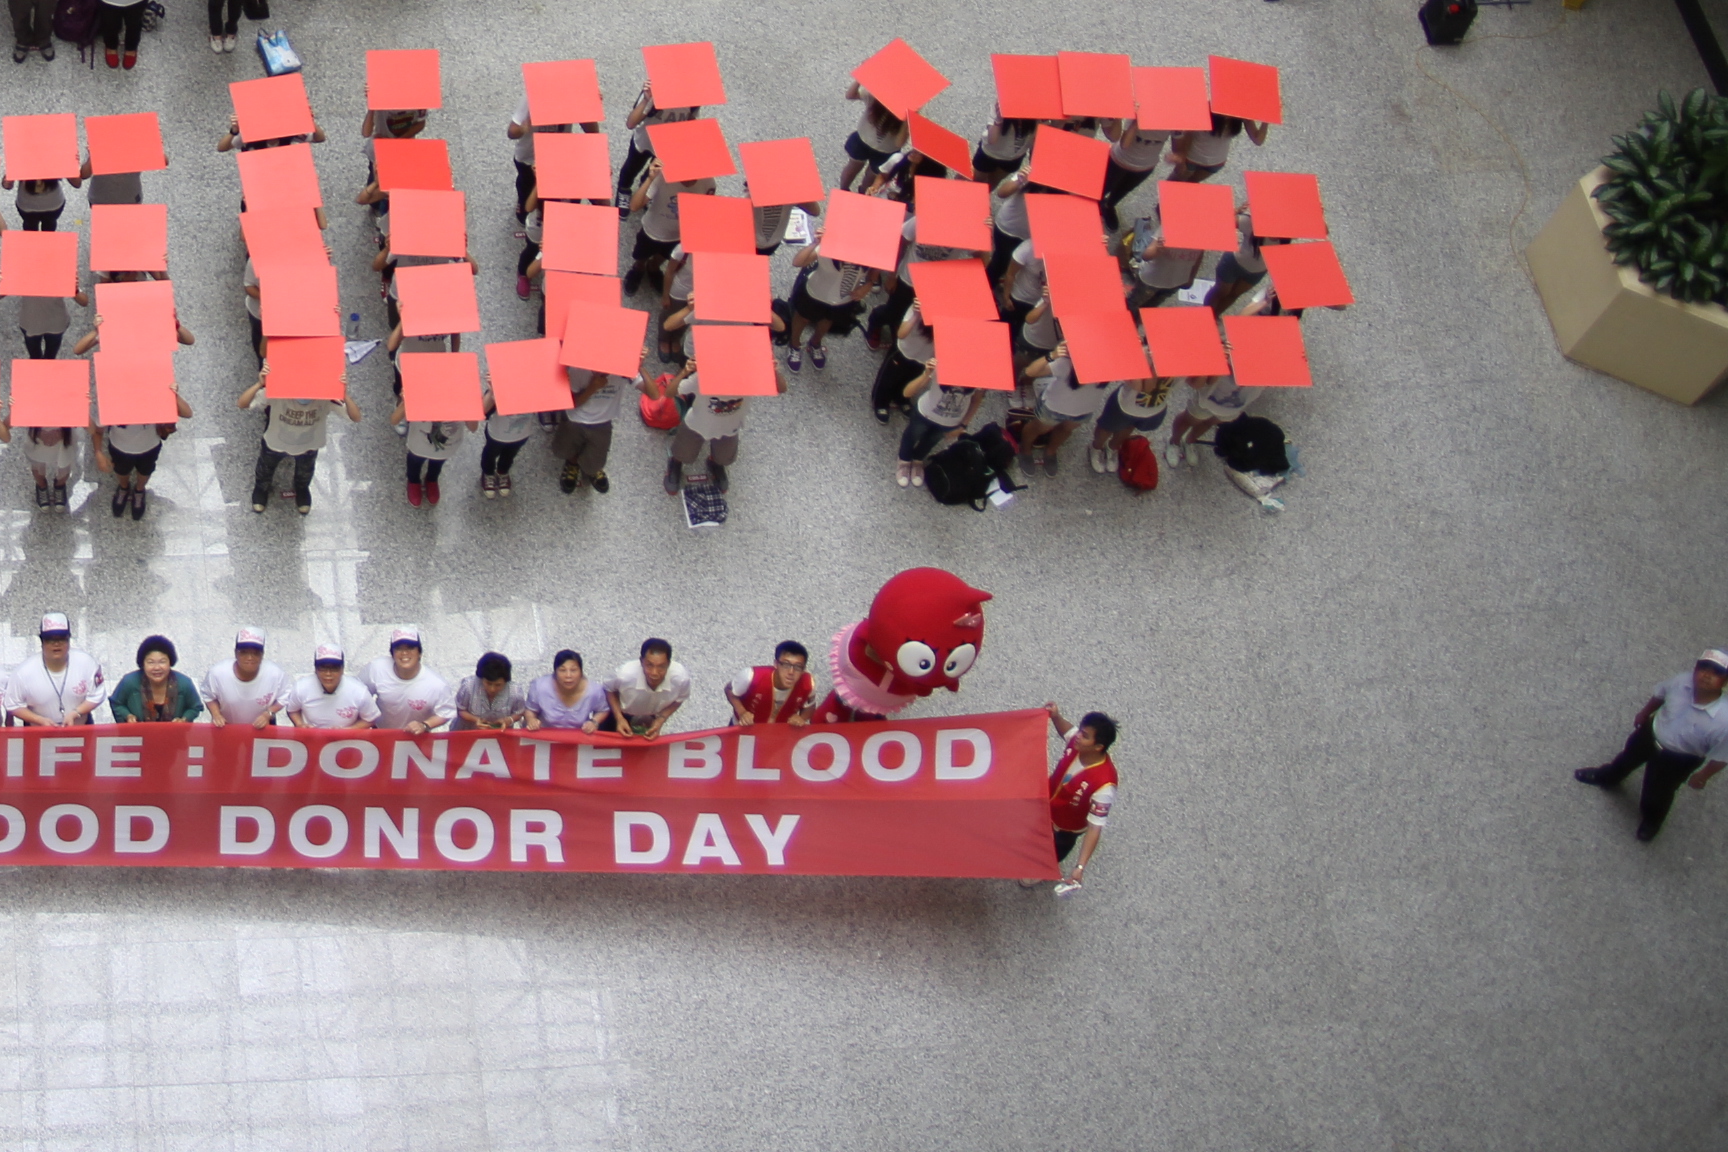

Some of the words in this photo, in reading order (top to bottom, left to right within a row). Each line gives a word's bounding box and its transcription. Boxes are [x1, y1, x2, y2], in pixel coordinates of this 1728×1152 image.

[251, 737, 623, 780] DONATE
[667, 728, 992, 782] BLOOD
[219, 805, 566, 863] DONOR
[613, 811, 802, 866] DAY
